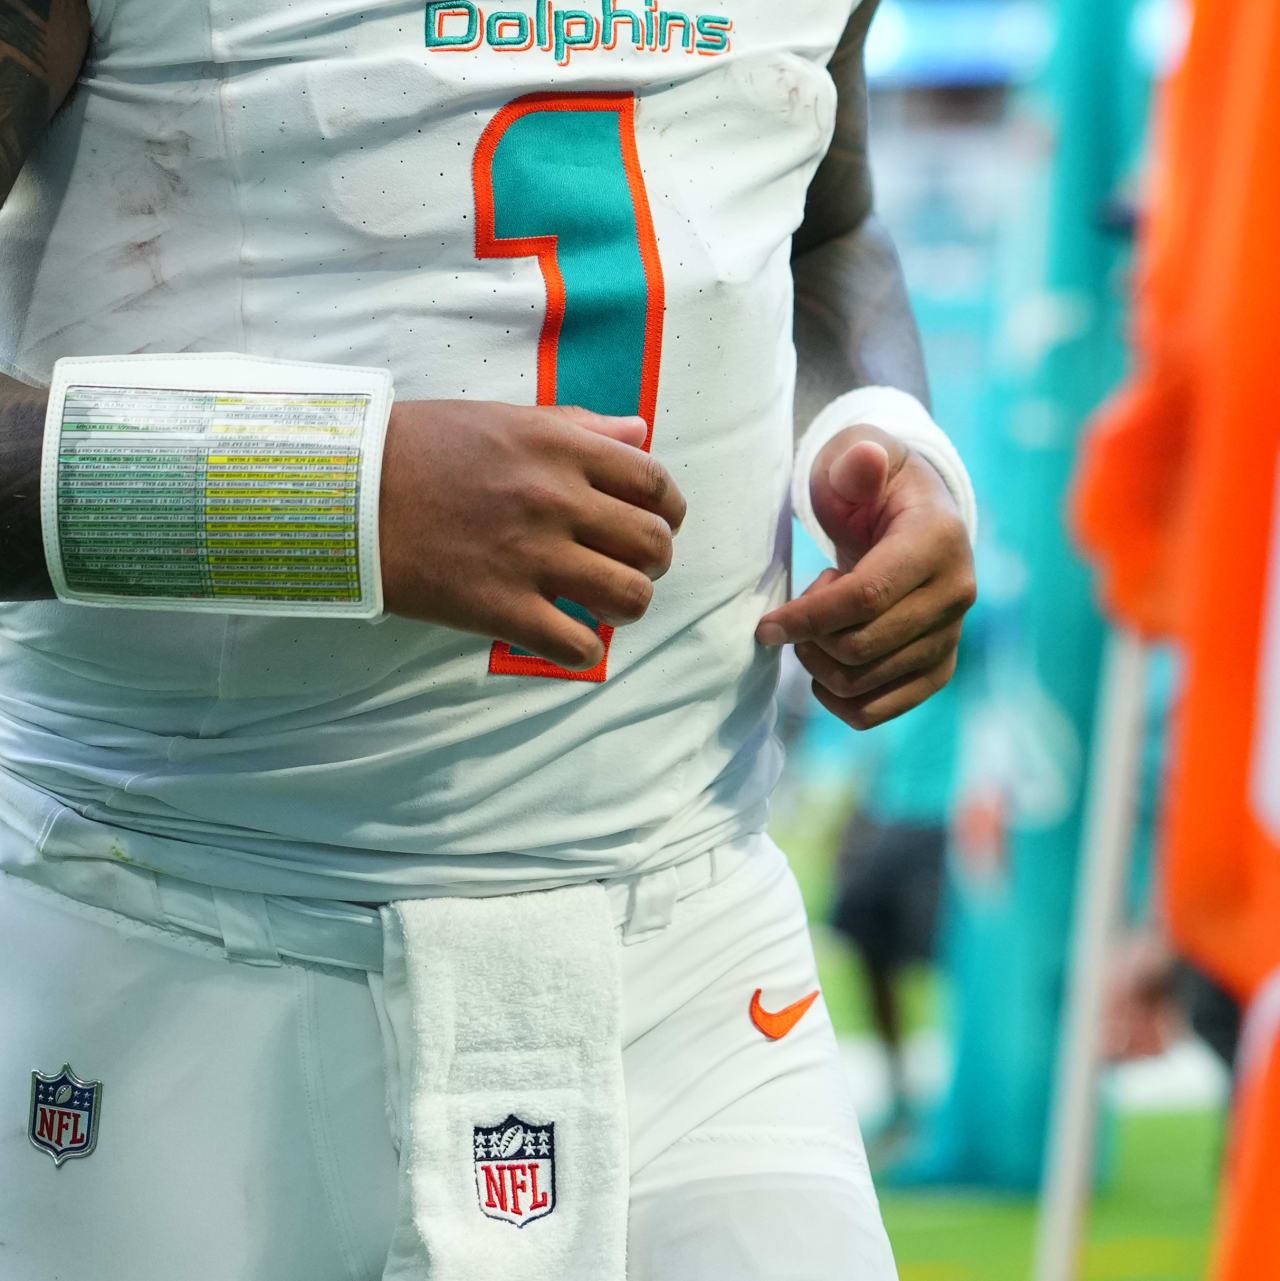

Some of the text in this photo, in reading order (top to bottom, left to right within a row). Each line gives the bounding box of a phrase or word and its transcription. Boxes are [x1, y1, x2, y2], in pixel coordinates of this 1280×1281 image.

[472, 91, 665, 682] 1
[37, 1107, 85, 1147] NFL
[481, 1163, 548, 1216] NFL
